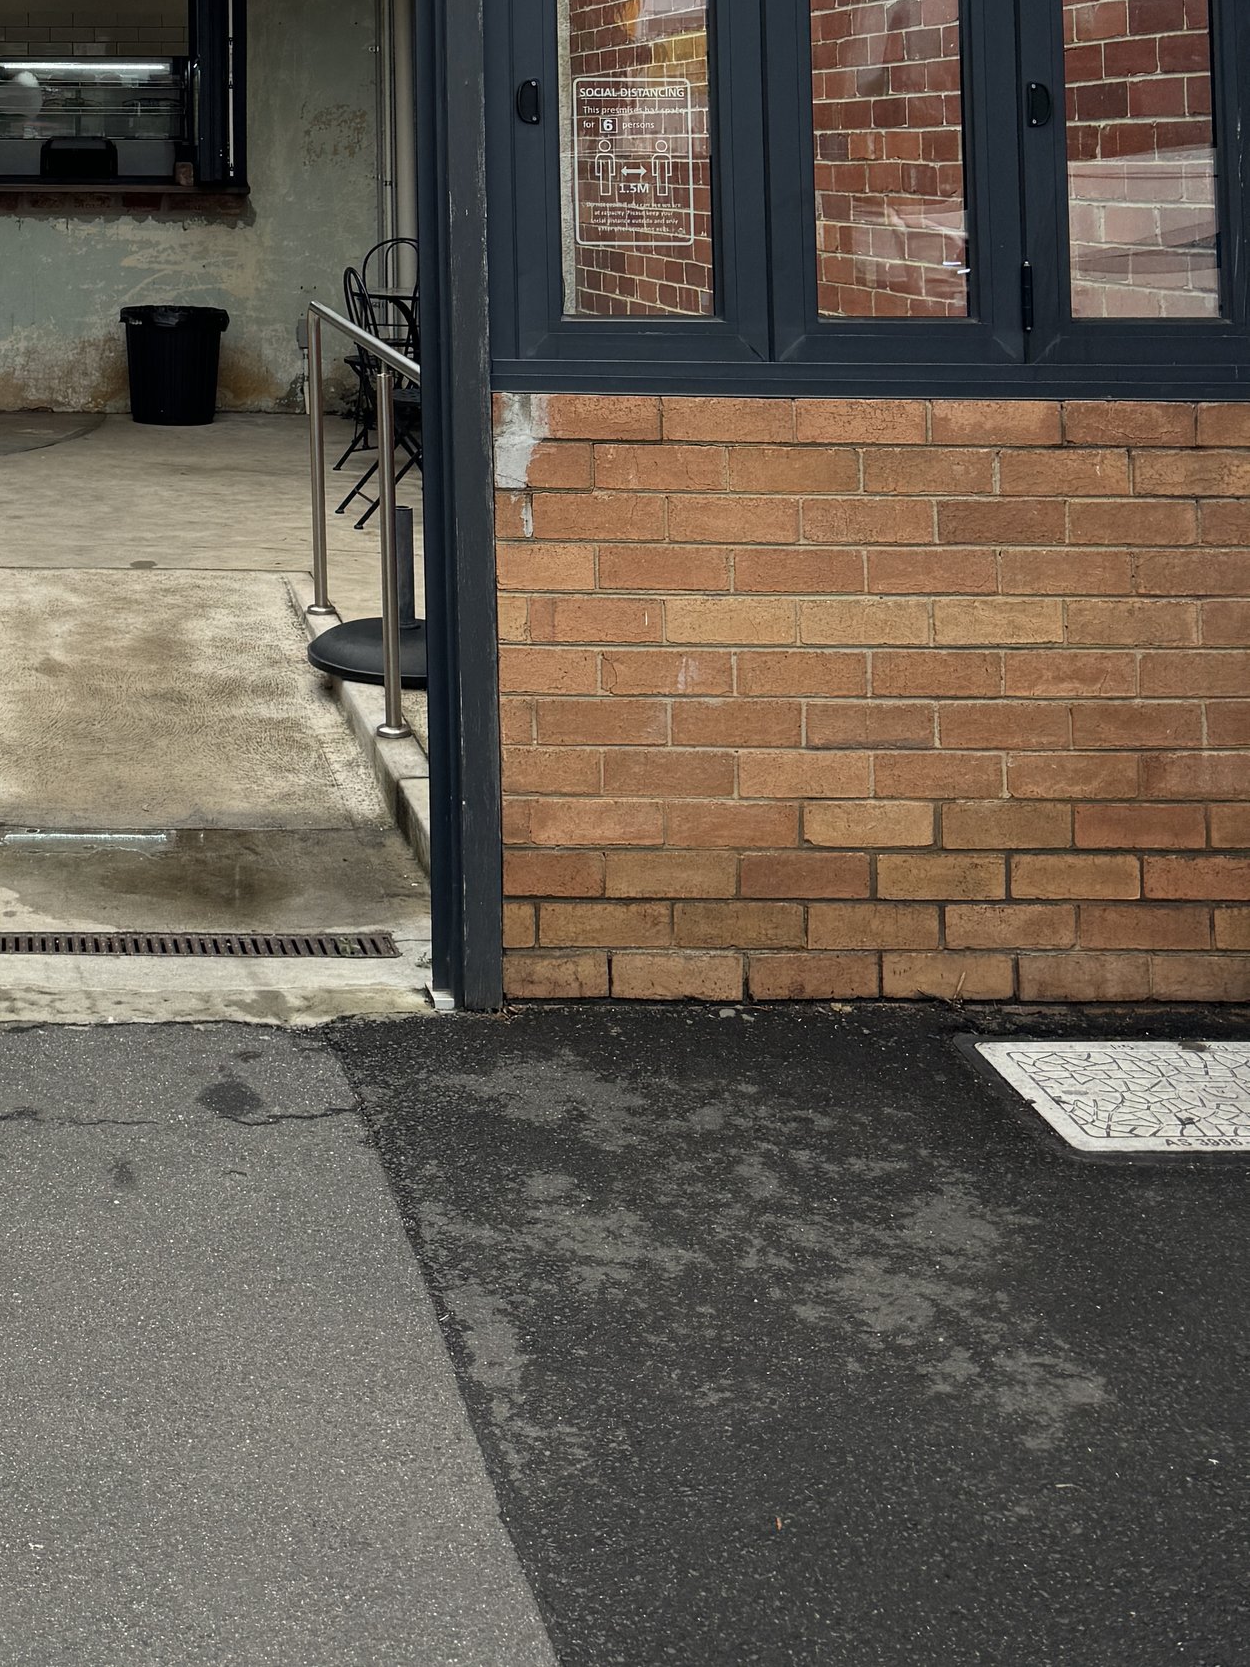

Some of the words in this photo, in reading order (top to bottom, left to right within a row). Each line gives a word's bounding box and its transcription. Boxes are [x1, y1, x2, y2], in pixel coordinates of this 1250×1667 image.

[579, 87, 617, 98] SOCIAL
[620, 87, 685, 98] DISTANCING
[582, 105, 600, 114] This
[583, 120, 595, 128] for
[602, 119, 613, 131] 6
[622, 122, 655, 130] persons
[619, 182, 649, 194] 1.5M
[1165, 1138, 1193, 1147] AS
